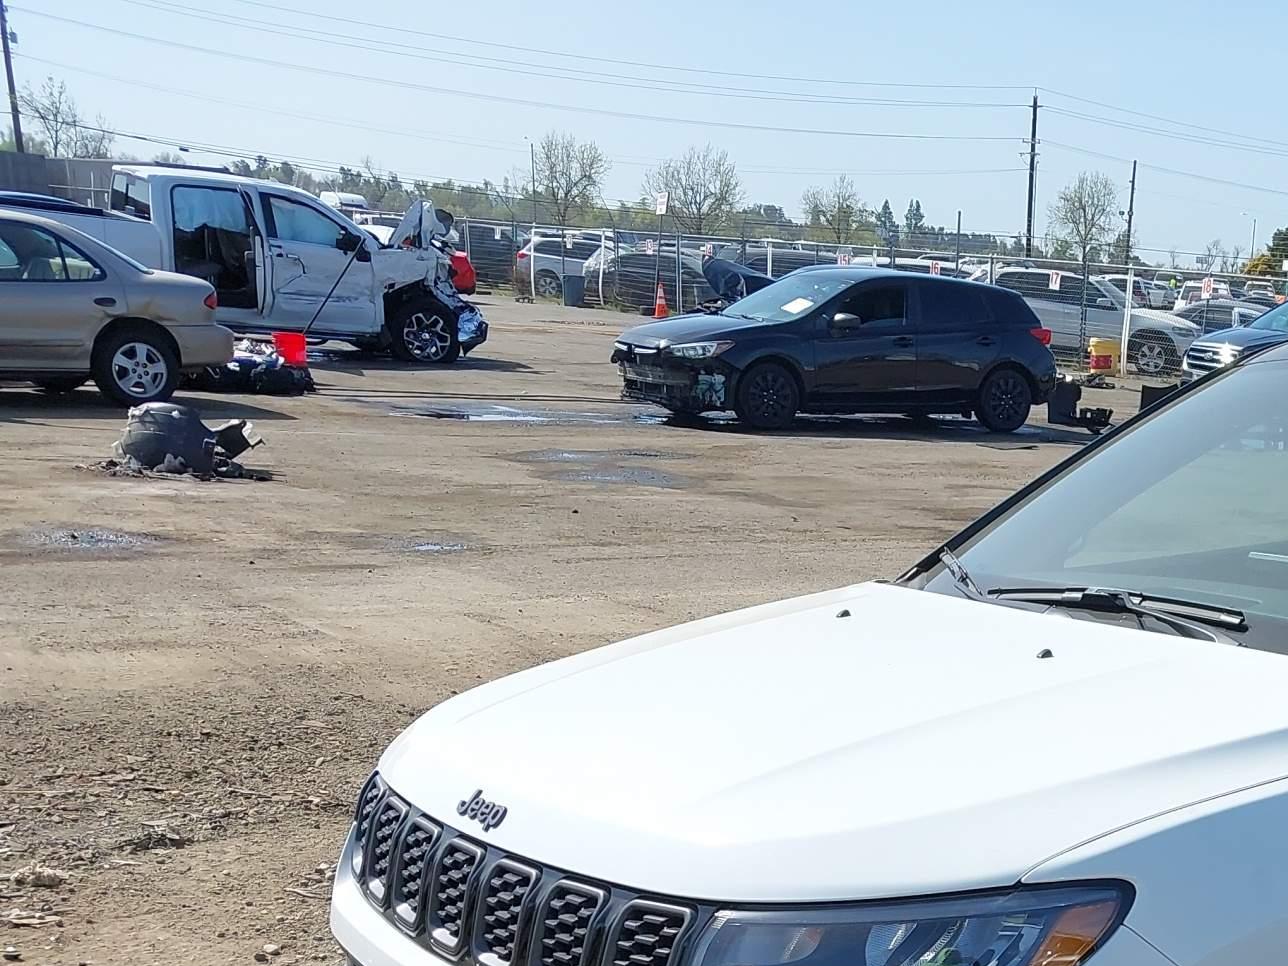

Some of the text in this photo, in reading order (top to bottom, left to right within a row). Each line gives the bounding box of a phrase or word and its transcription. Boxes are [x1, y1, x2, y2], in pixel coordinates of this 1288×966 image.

[931, 262, 940, 275] 16
[1050, 271, 1060, 286] 17
[1203, 278, 1213, 294] 18
[456, 788, 508, 833] Jeep
